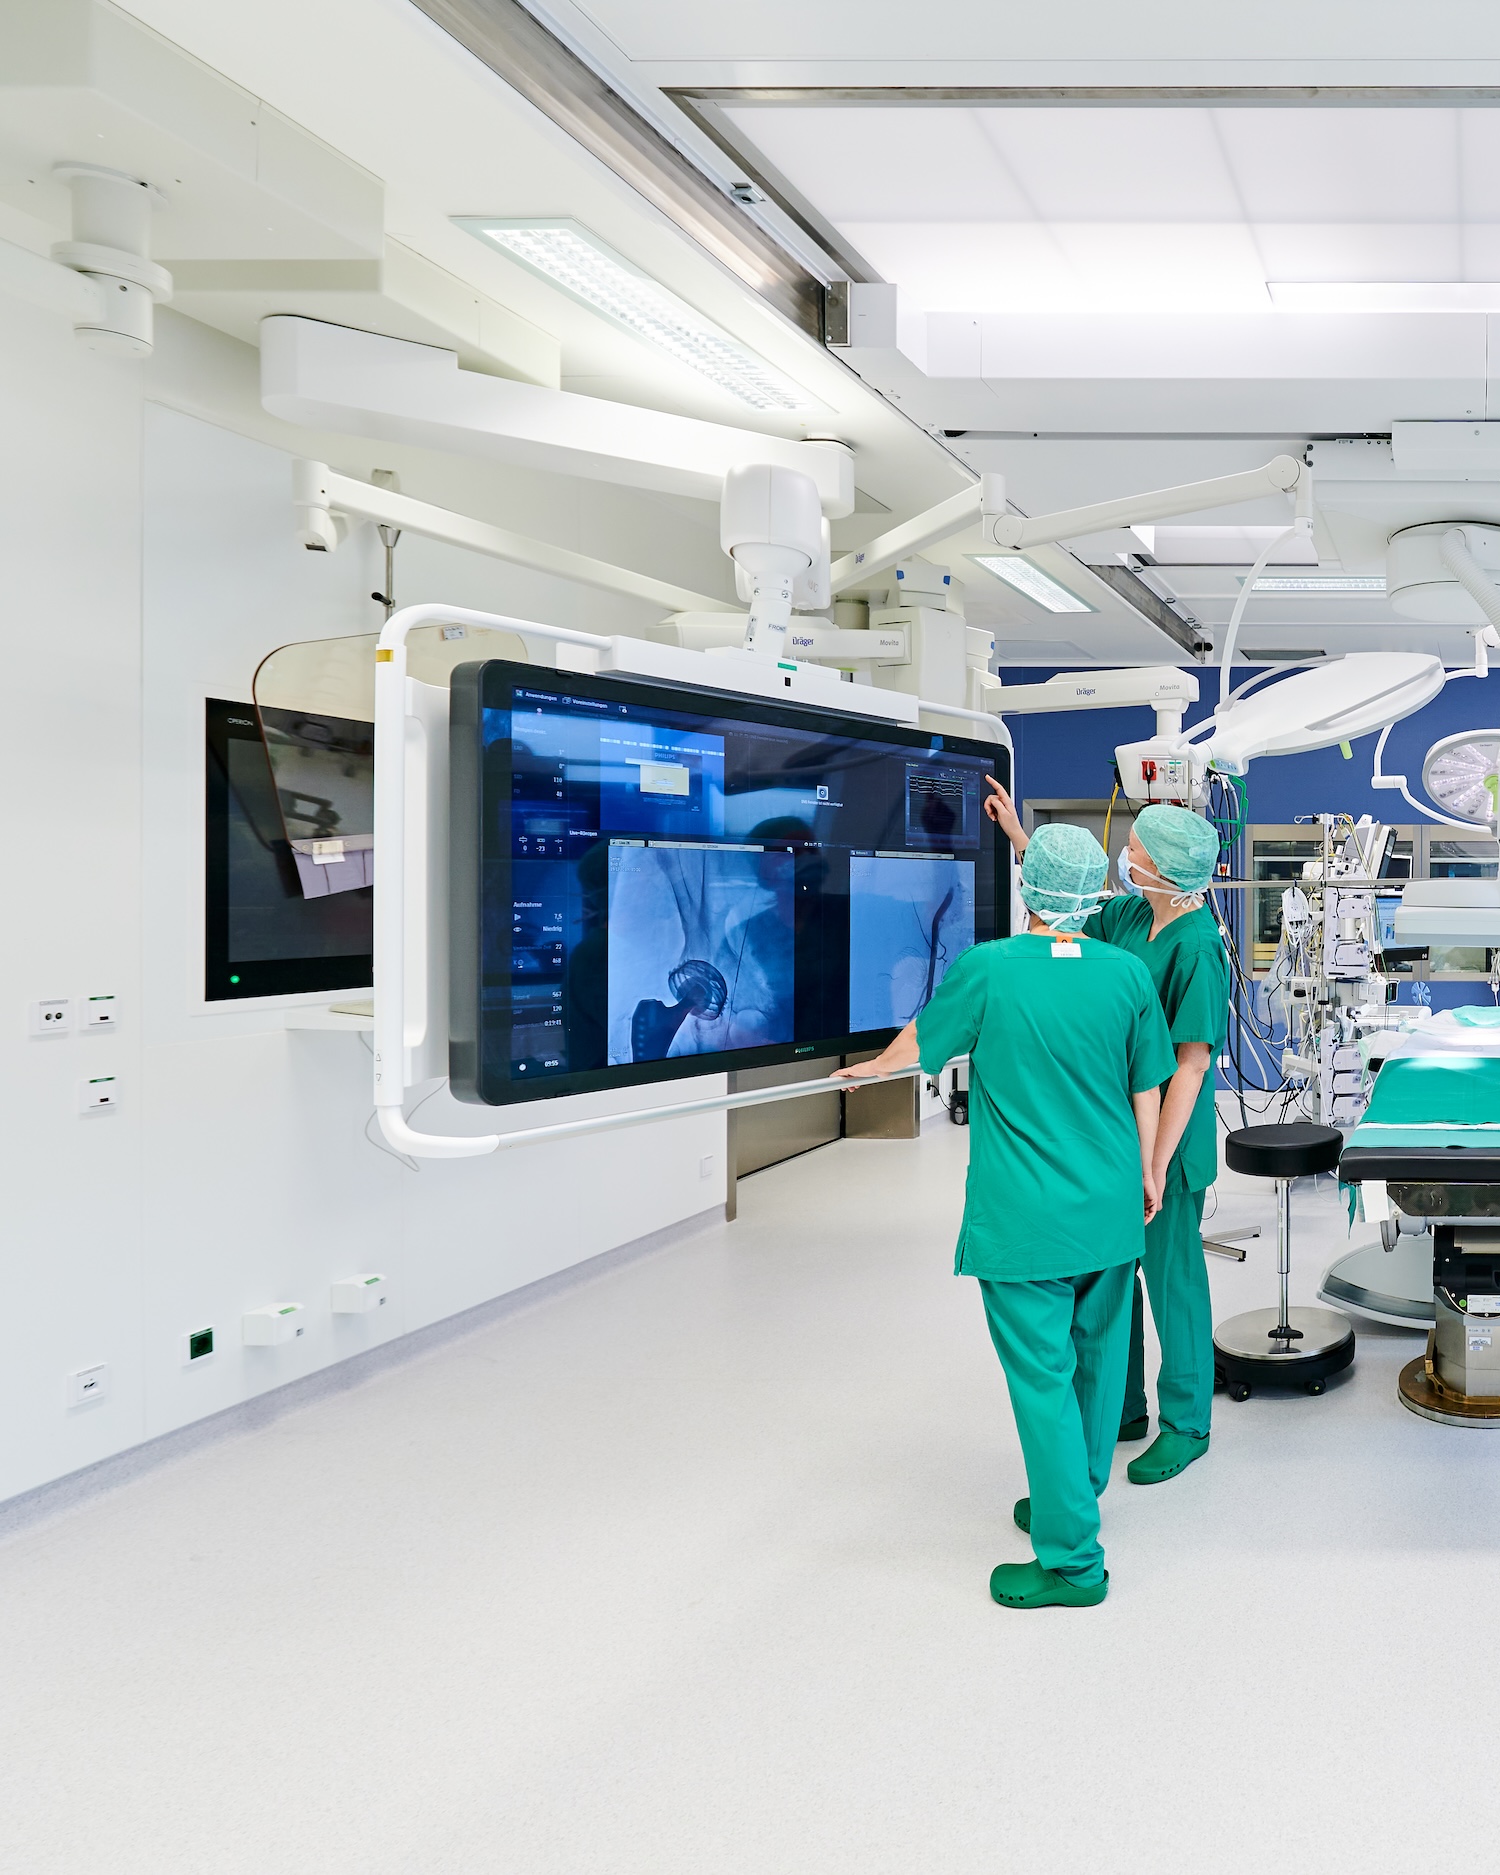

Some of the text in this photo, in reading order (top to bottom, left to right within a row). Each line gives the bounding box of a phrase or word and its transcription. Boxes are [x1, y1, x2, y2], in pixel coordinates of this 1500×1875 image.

[792, 636, 815, 647] Dräger
[879, 639, 900, 647] Movita
[1075, 687, 1097, 696] Dräger
[794, 1046, 815, 1054] PHILIPS
